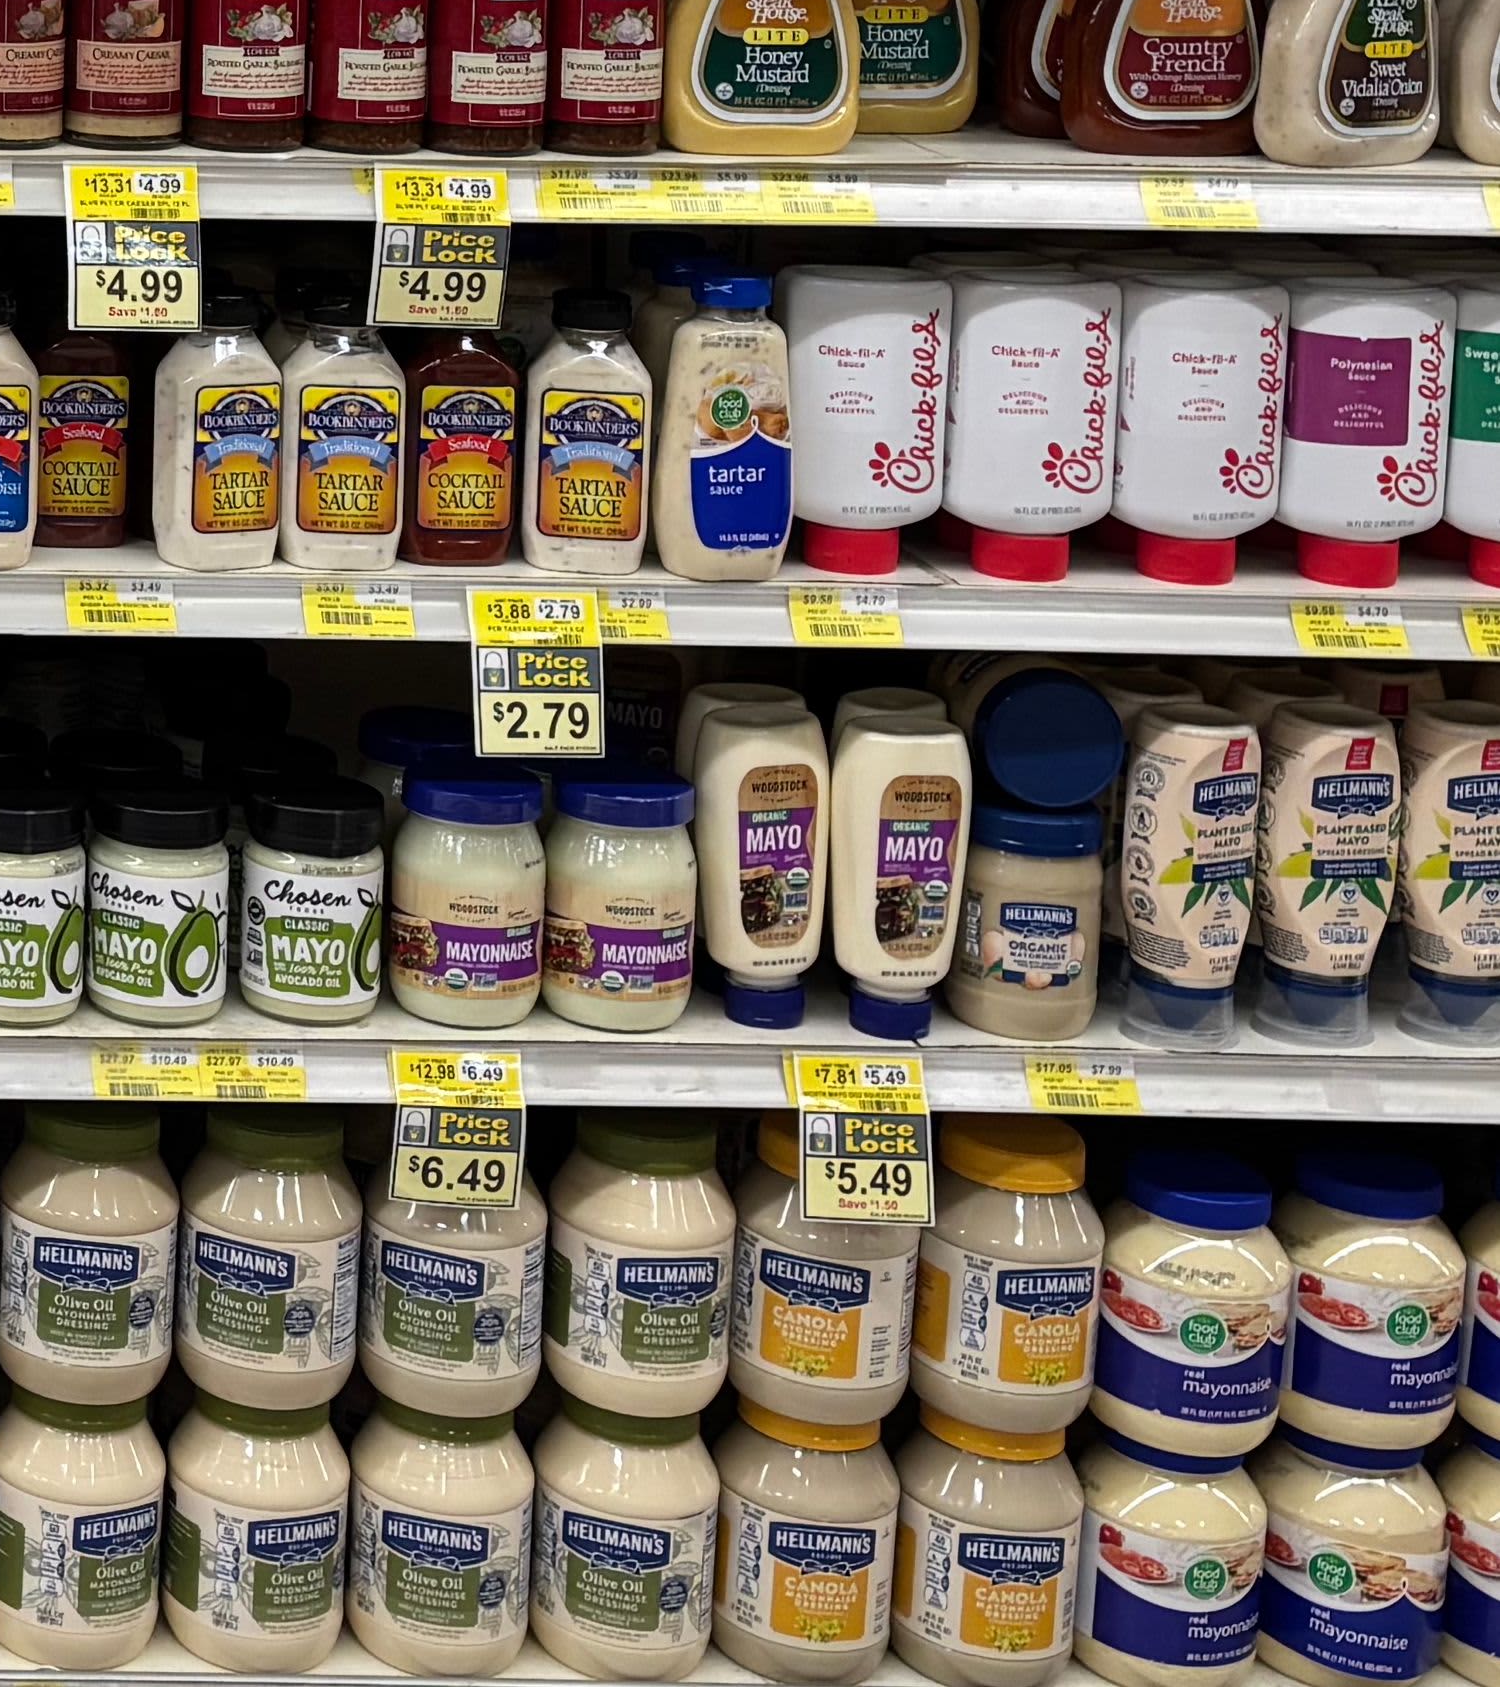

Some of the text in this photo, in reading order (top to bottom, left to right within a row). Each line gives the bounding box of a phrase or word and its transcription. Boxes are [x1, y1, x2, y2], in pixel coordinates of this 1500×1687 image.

[753, 3, 807, 23] House
[751, 30, 801, 43] LITE
[744, 48, 803, 69] Honey
[1144, 38, 1233, 61] Country
[1151, 56, 1226, 74] French
[1370, 62, 1407, 80] Sweet
[735, 65, 809, 84] Mustard
[1342, 76, 1423, 98] Vidalia Onion
[818, 344, 885, 358] Chick-fil-A
[1330, 357, 1393, 371] Polynesian
[887, 309, 940, 494] Chick-fil-A
[324, 442, 380, 457] Traditional
[43, 461, 119, 476] COCKTAIL
[708, 463, 766, 483] tartar
[316, 473, 384, 492] TARTAR
[517, 653, 587, 671] Price
[493, 701, 590, 738] $2.79
[895, 789, 952, 804] WOODSTOCK
[1316, 825, 1387, 837] PLANT BASED
[884, 838, 943, 862] MAYO
[446, 940, 533, 962] MAYONNAISE
[410, 1064, 455, 1079] $12.98
[463, 1065, 503, 1081] $6.49
[409, 1159, 506, 1192] $6.49
[825, 1161, 912, 1198] $5.49
[838, 1198, 899, 1211] Save $1.50
[1014, 1322, 1081, 1340] CANOLA
[1184, 1369, 1205, 1379] real
[1183, 1378, 1272, 1395] mayonnaise
